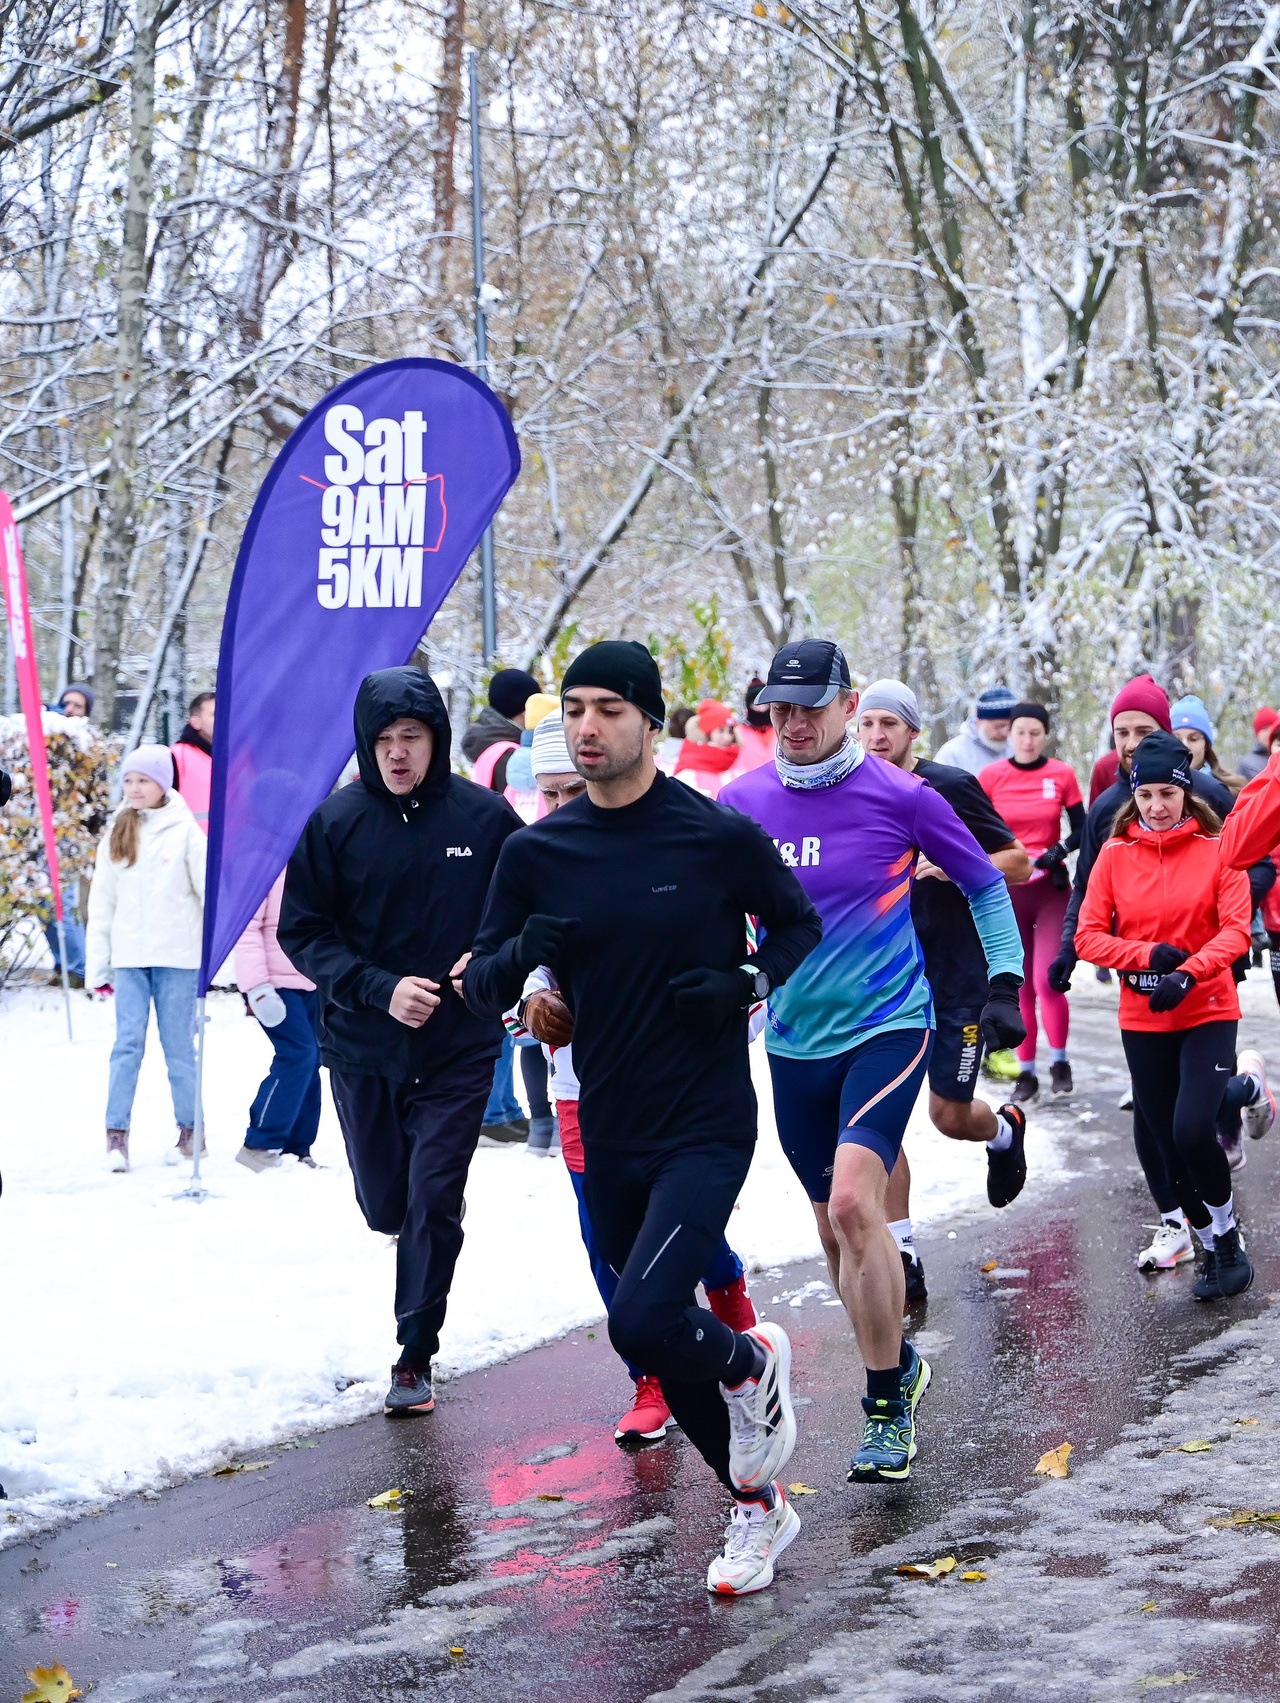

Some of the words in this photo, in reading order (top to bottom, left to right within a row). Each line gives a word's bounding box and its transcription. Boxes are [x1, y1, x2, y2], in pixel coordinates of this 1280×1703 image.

[324, 404, 427, 485] Sat
[321, 485, 426, 547] 9AM
[317, 547, 423, 609] 5KM
[446, 846, 473, 858] FILA
[772, 836, 821, 868] &R
